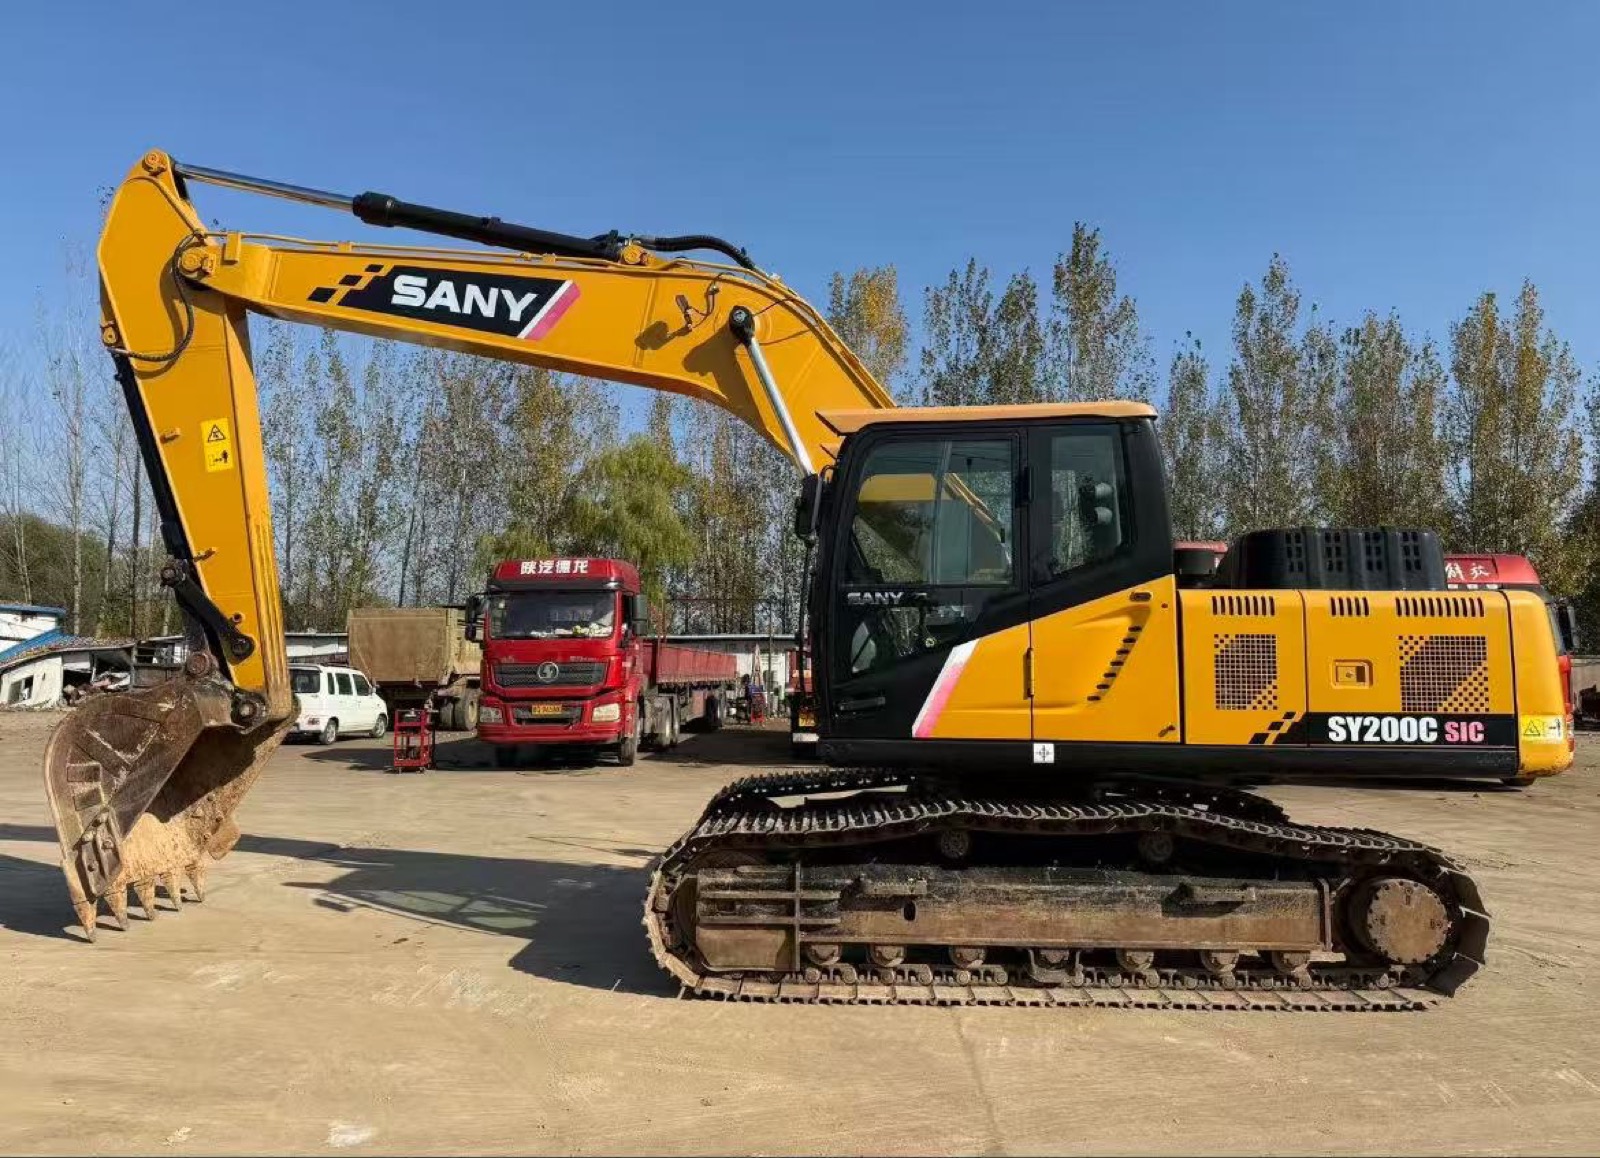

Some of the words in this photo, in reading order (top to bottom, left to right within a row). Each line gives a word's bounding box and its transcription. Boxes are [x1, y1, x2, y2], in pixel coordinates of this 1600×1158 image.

[391, 274, 537, 322] SANY
[847, 591, 904, 605] SANY
[1327, 716, 1438, 743] SY200C
[1444, 721, 1485, 743] SIC
